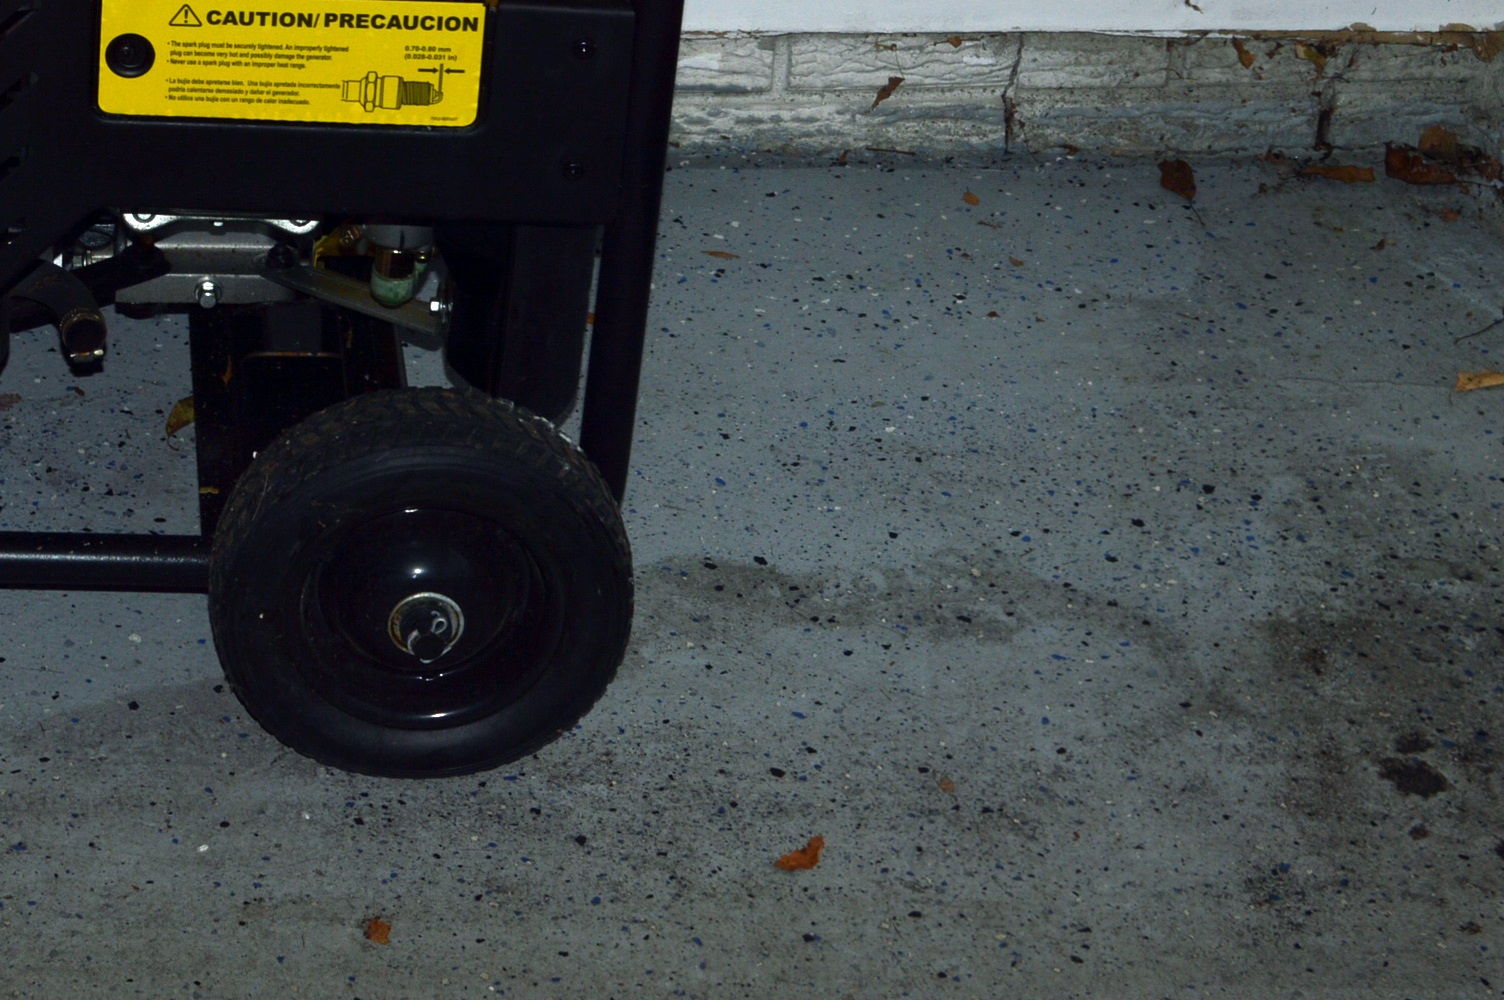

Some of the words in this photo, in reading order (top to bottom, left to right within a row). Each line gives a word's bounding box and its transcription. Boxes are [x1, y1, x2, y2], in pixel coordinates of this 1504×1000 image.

[324, 13, 478, 32] PRECAUCION
[234, 43, 256, 51] securely
[294, 45, 322, 53] improperly
[274, 53, 295, 61] damage
[218, 60, 230, 68] plug
